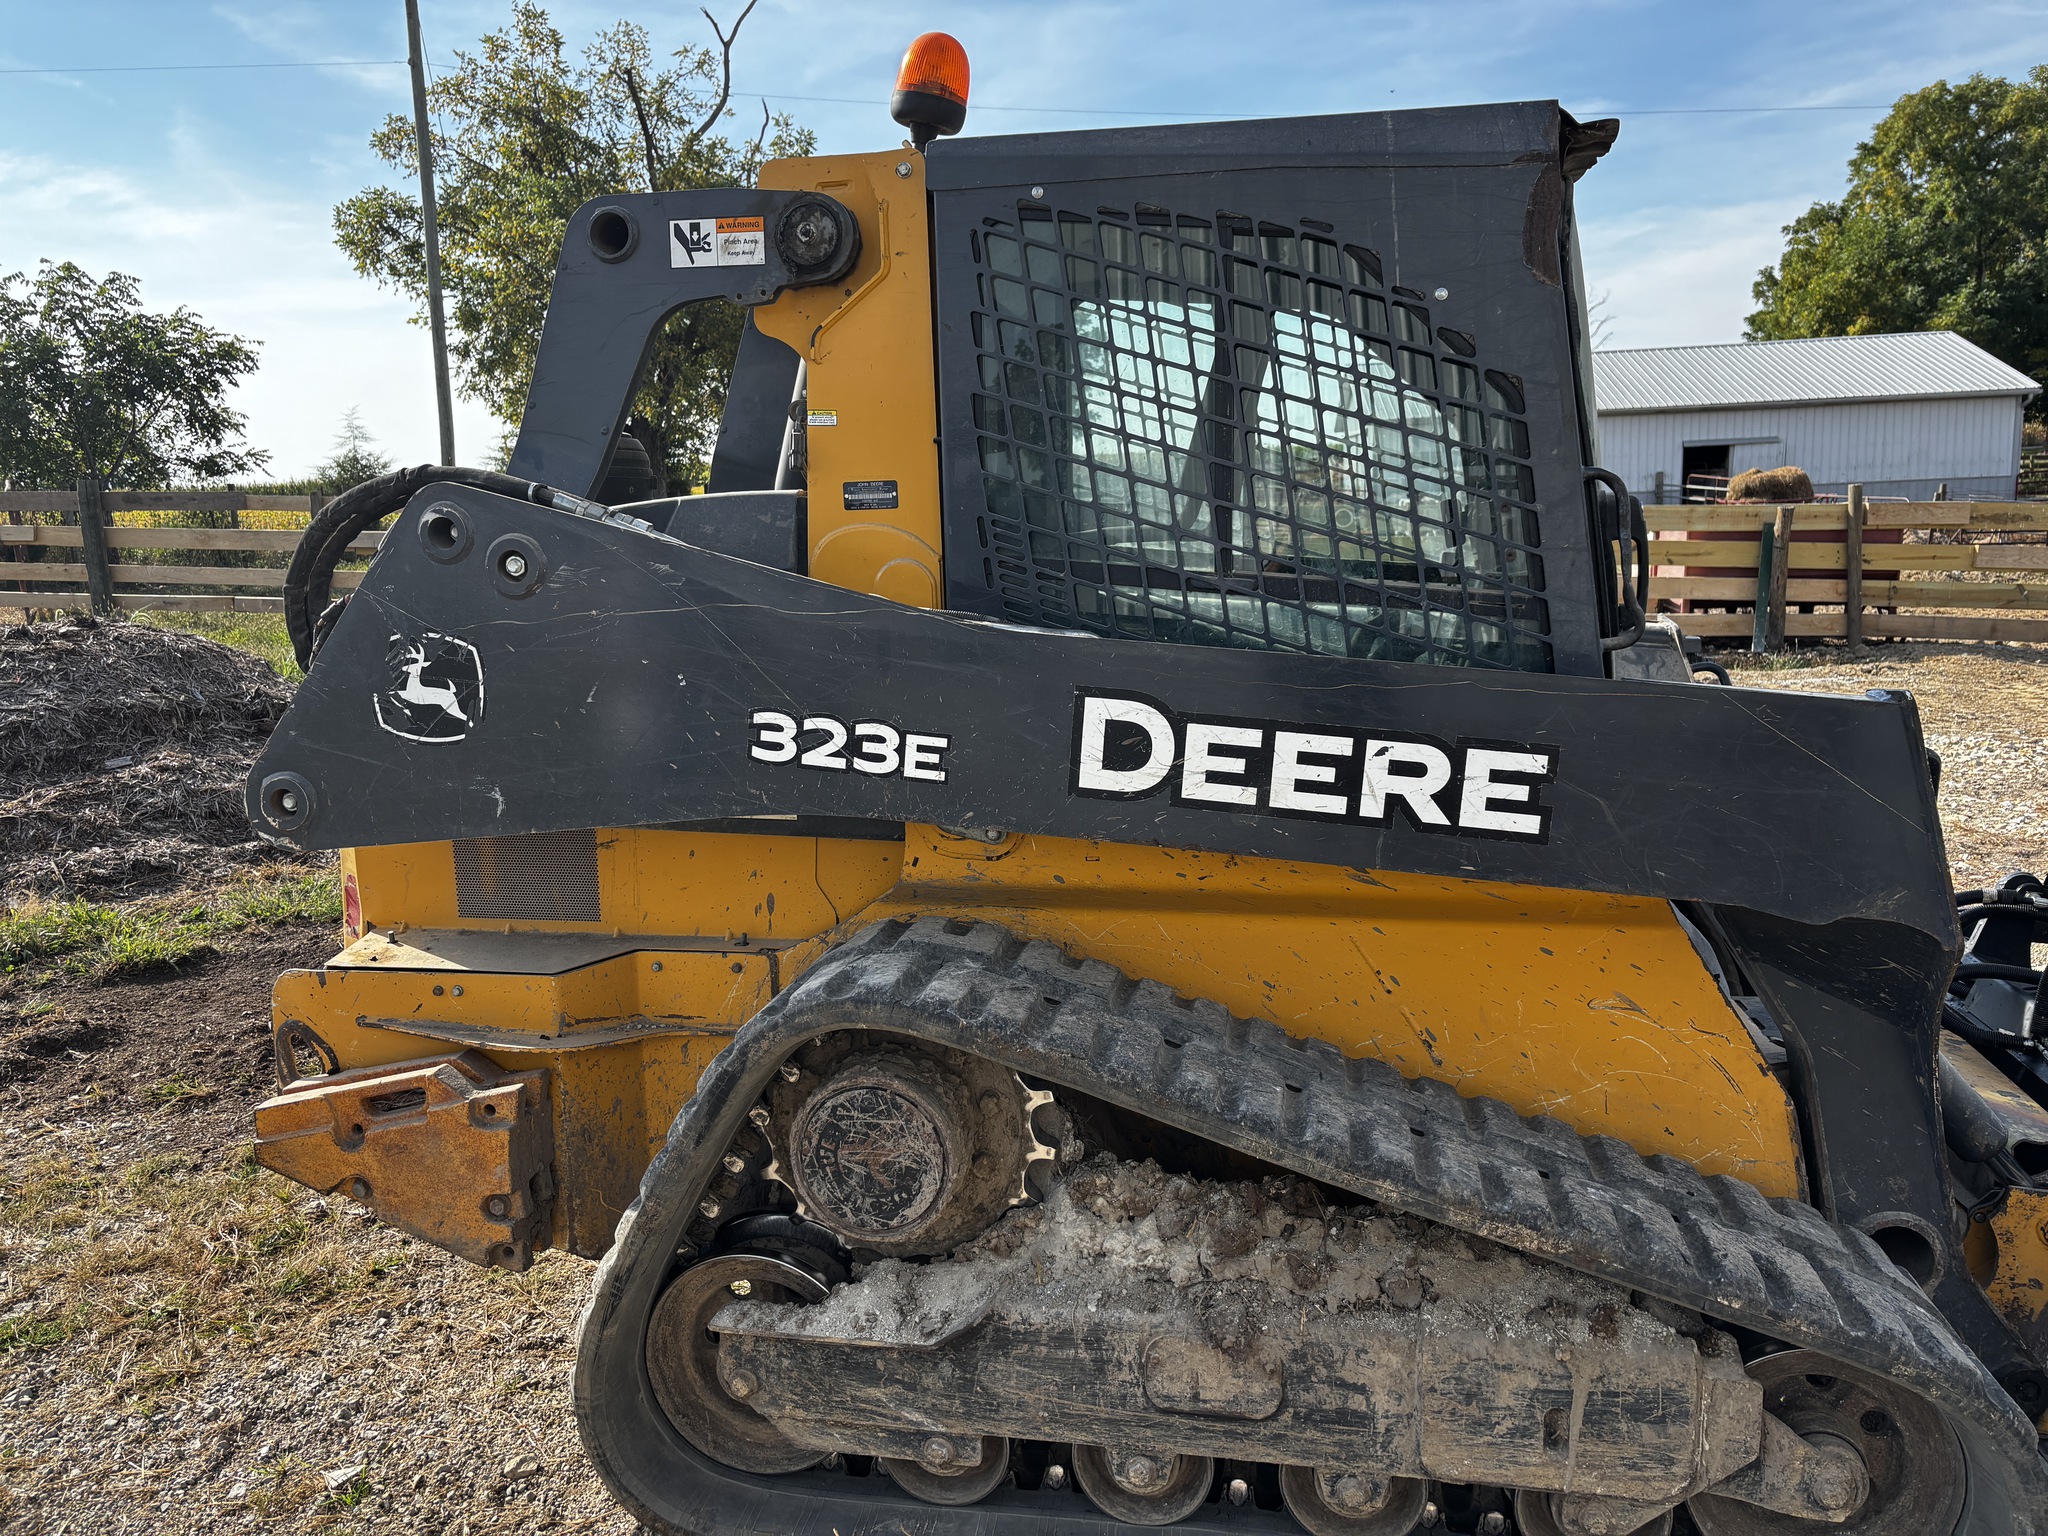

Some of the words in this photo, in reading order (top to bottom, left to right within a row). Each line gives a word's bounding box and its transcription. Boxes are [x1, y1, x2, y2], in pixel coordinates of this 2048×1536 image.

[725, 221, 760, 229] WARNING
[751, 711, 949, 782] 323E
[1078, 696, 1550, 835] DEERE
